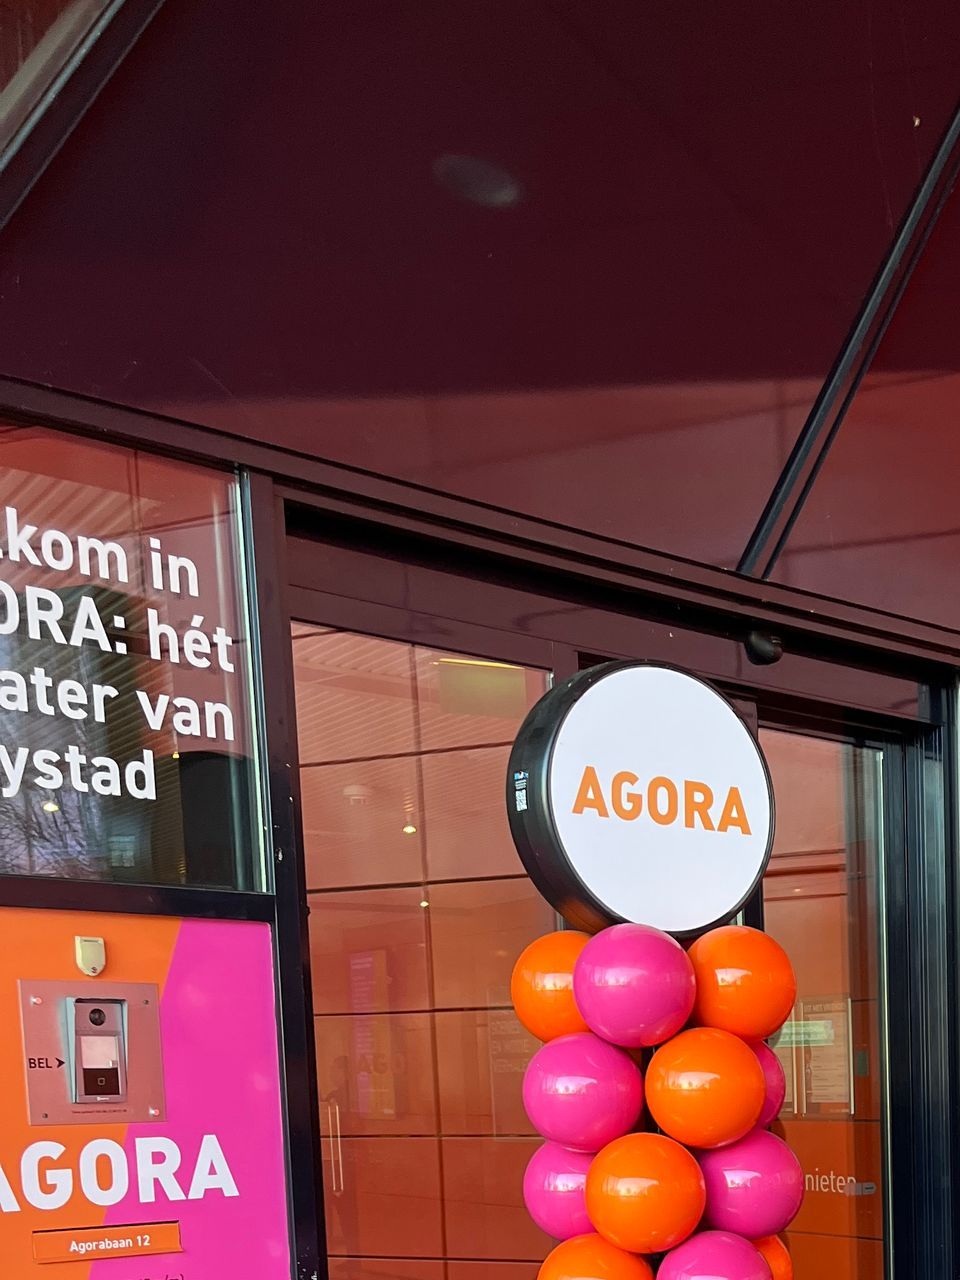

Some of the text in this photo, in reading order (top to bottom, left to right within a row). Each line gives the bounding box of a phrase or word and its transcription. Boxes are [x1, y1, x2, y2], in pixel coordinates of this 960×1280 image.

[0, 506, 200, 597] kom in
[147, 608, 235, 673] hét
[136, 690, 235, 741] van
[0, 745, 156, 800] ystad
[572, 766, 752, 835] AGORA
[28, 1058, 52, 1069] BEL
[69, 1234, 151, 1254] Agorabaan 12
